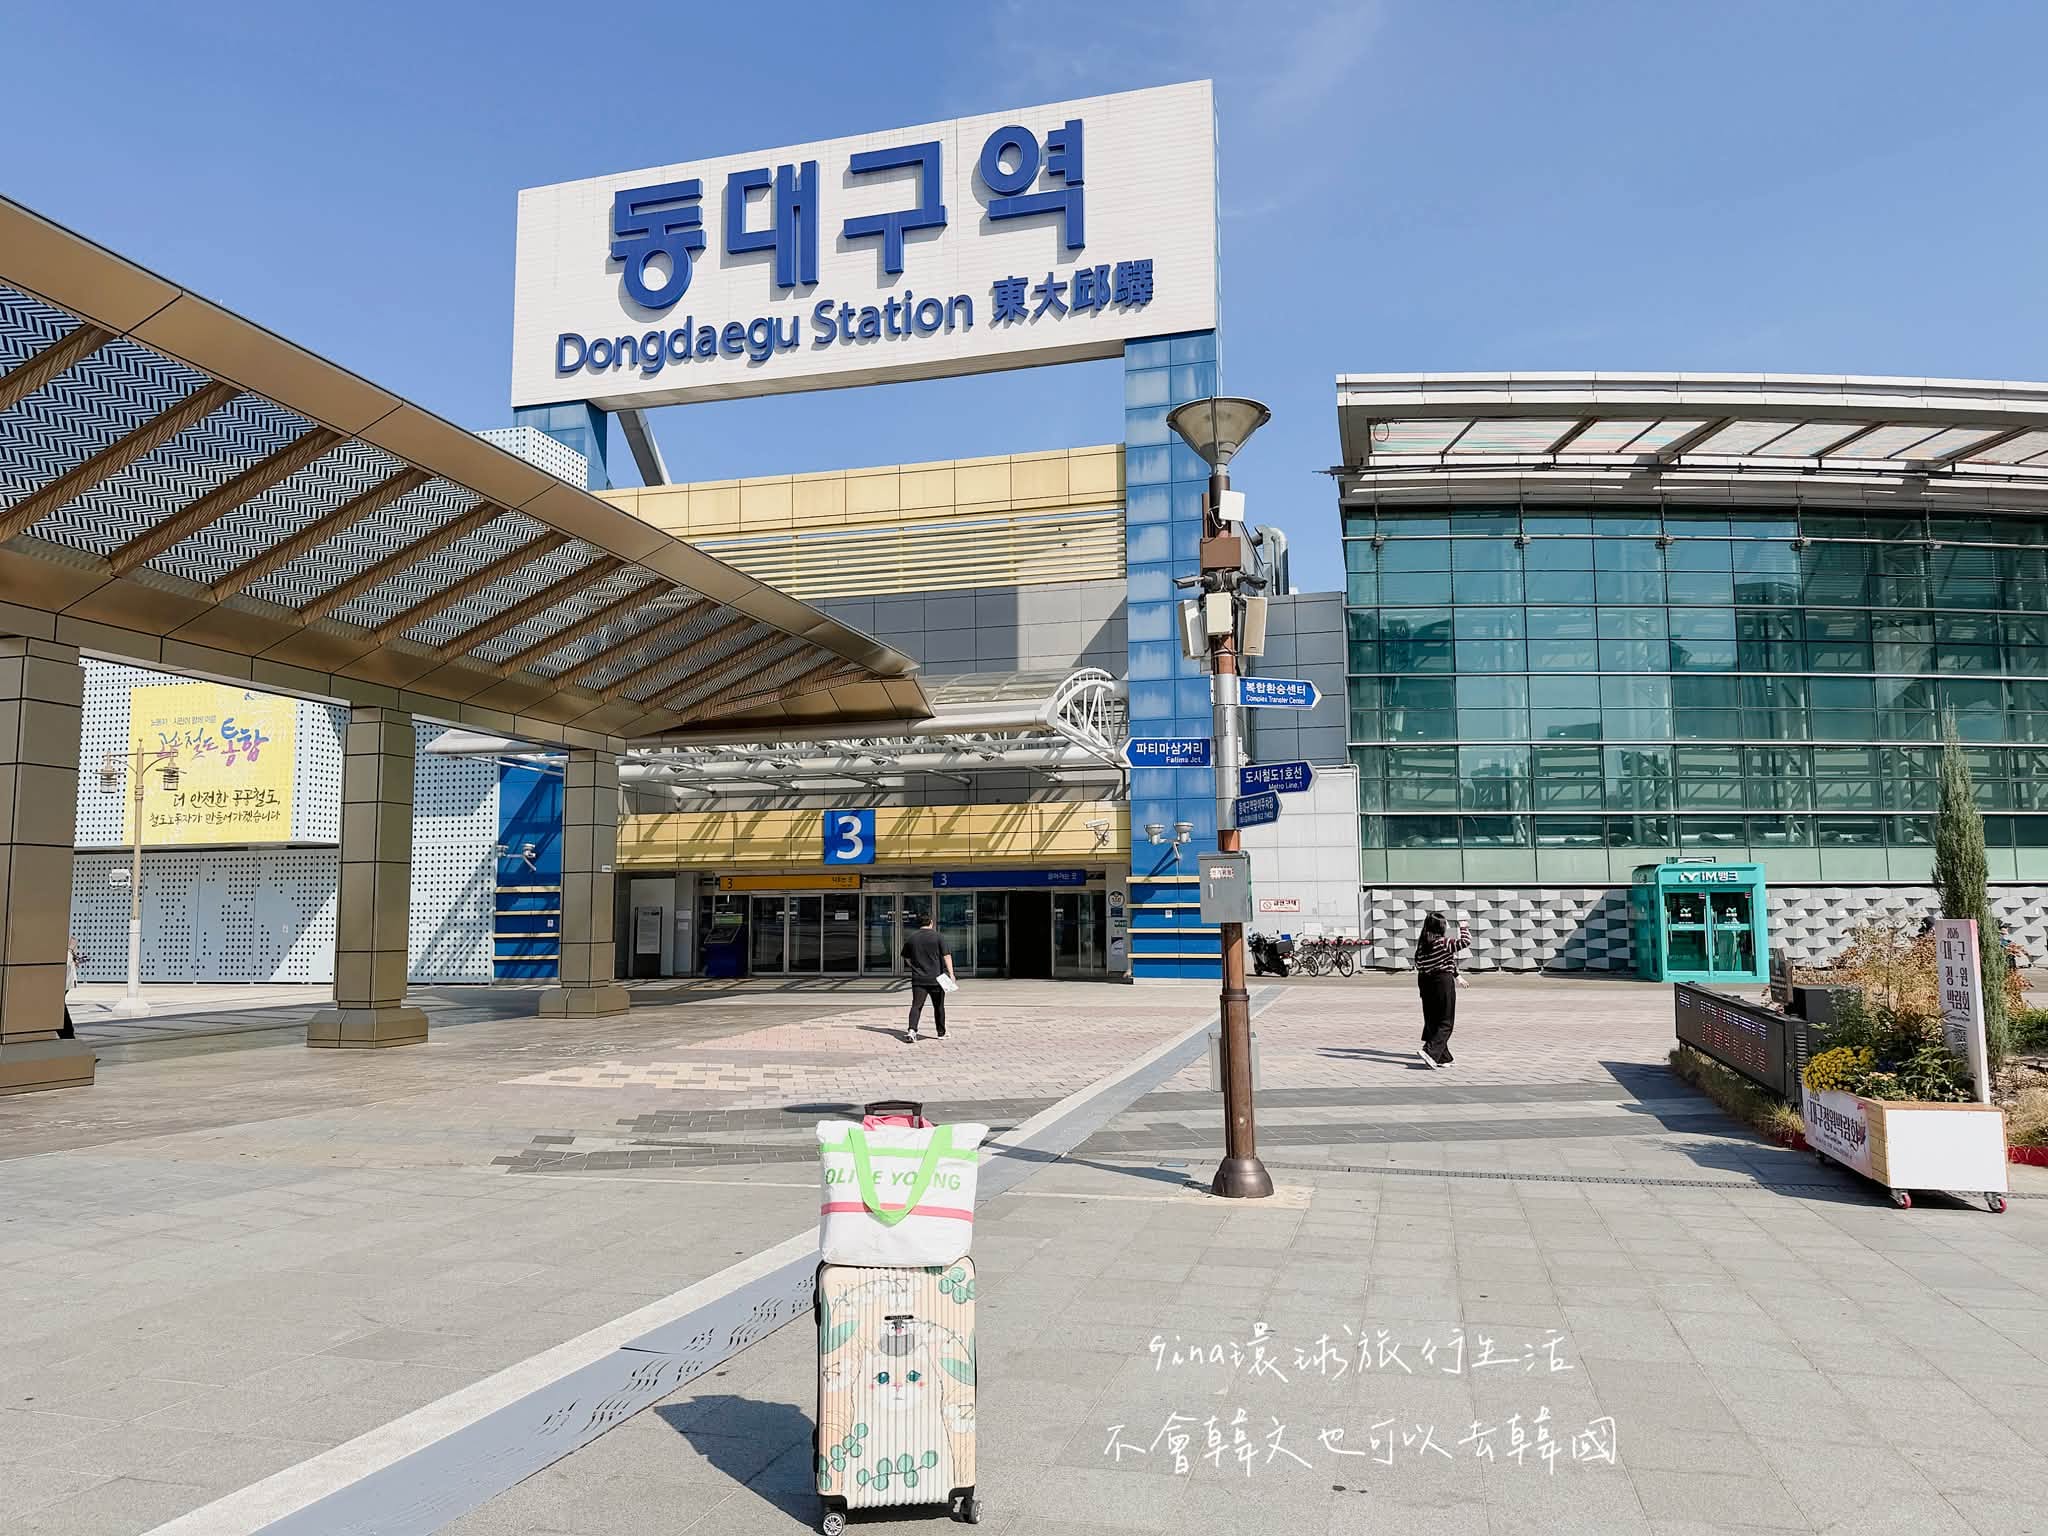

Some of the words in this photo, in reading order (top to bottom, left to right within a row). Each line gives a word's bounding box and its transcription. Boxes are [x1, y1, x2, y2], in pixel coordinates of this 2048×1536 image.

[611, 119, 1084, 310] 동대구역
[992, 258, 1155, 323] 東大邱驛
[556, 311, 801, 376] Dongdaegu
[814, 288, 974, 346] Station
[1246, 682, 1306, 696] 복합환승센터
[1246, 695, 1267, 703] Complex
[1268, 695, 1288, 704] Transfer
[1289, 697, 1306, 705] Center
[220, 717, 269, 767] 통합
[1136, 742, 1203, 756] 파티마삼거리
[1166, 756, 1189, 764] Fatima
[1245, 765, 1303, 783] 도시철도1호선
[173, 792, 186, 807] 더
[190, 789, 229, 809] 안전한
[836, 815, 864, 860] 3
[727, 878, 733, 889] 3
[940, 873, 948, 886] 3
[825, 1168, 882, 1185] OLIE
[891, 1171, 961, 1191] YONG
